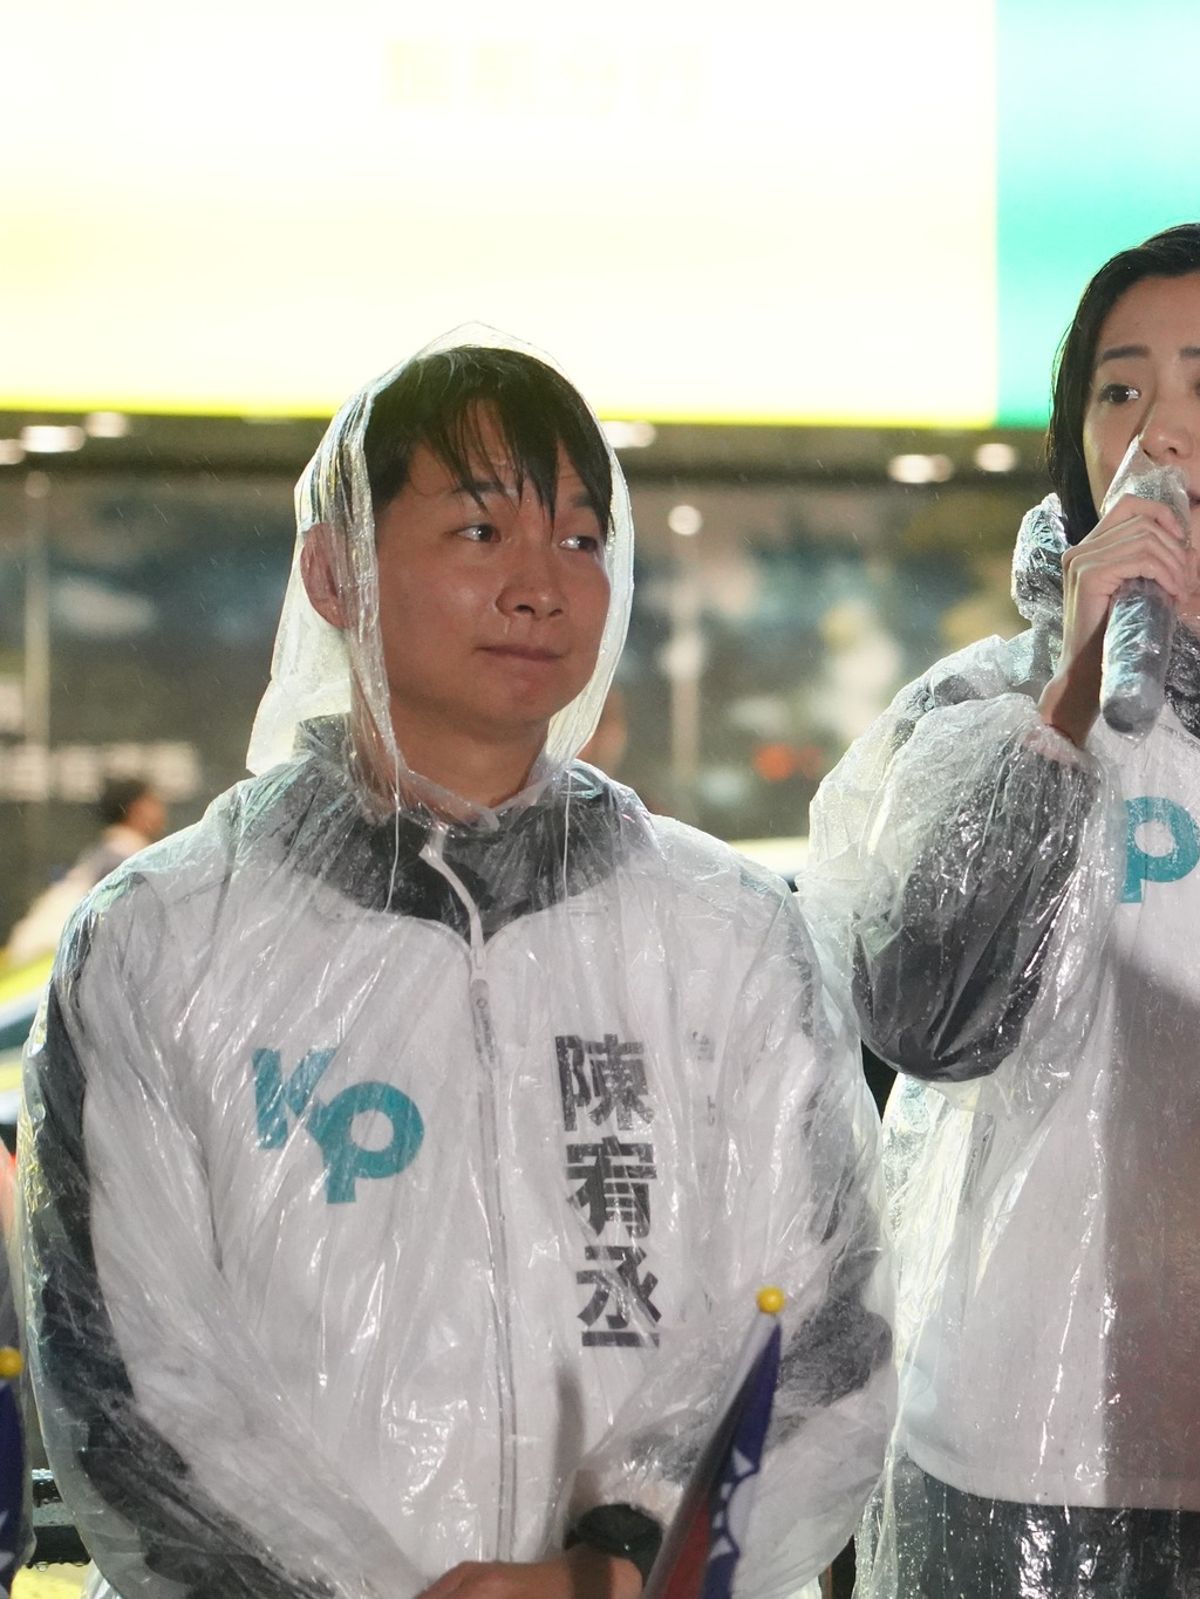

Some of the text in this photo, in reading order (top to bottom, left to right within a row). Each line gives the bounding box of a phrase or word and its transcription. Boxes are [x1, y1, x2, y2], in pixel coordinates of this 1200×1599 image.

[252, 1047, 425, 1204] KP
[555, 1034, 662, 1347] 陳宥丞
